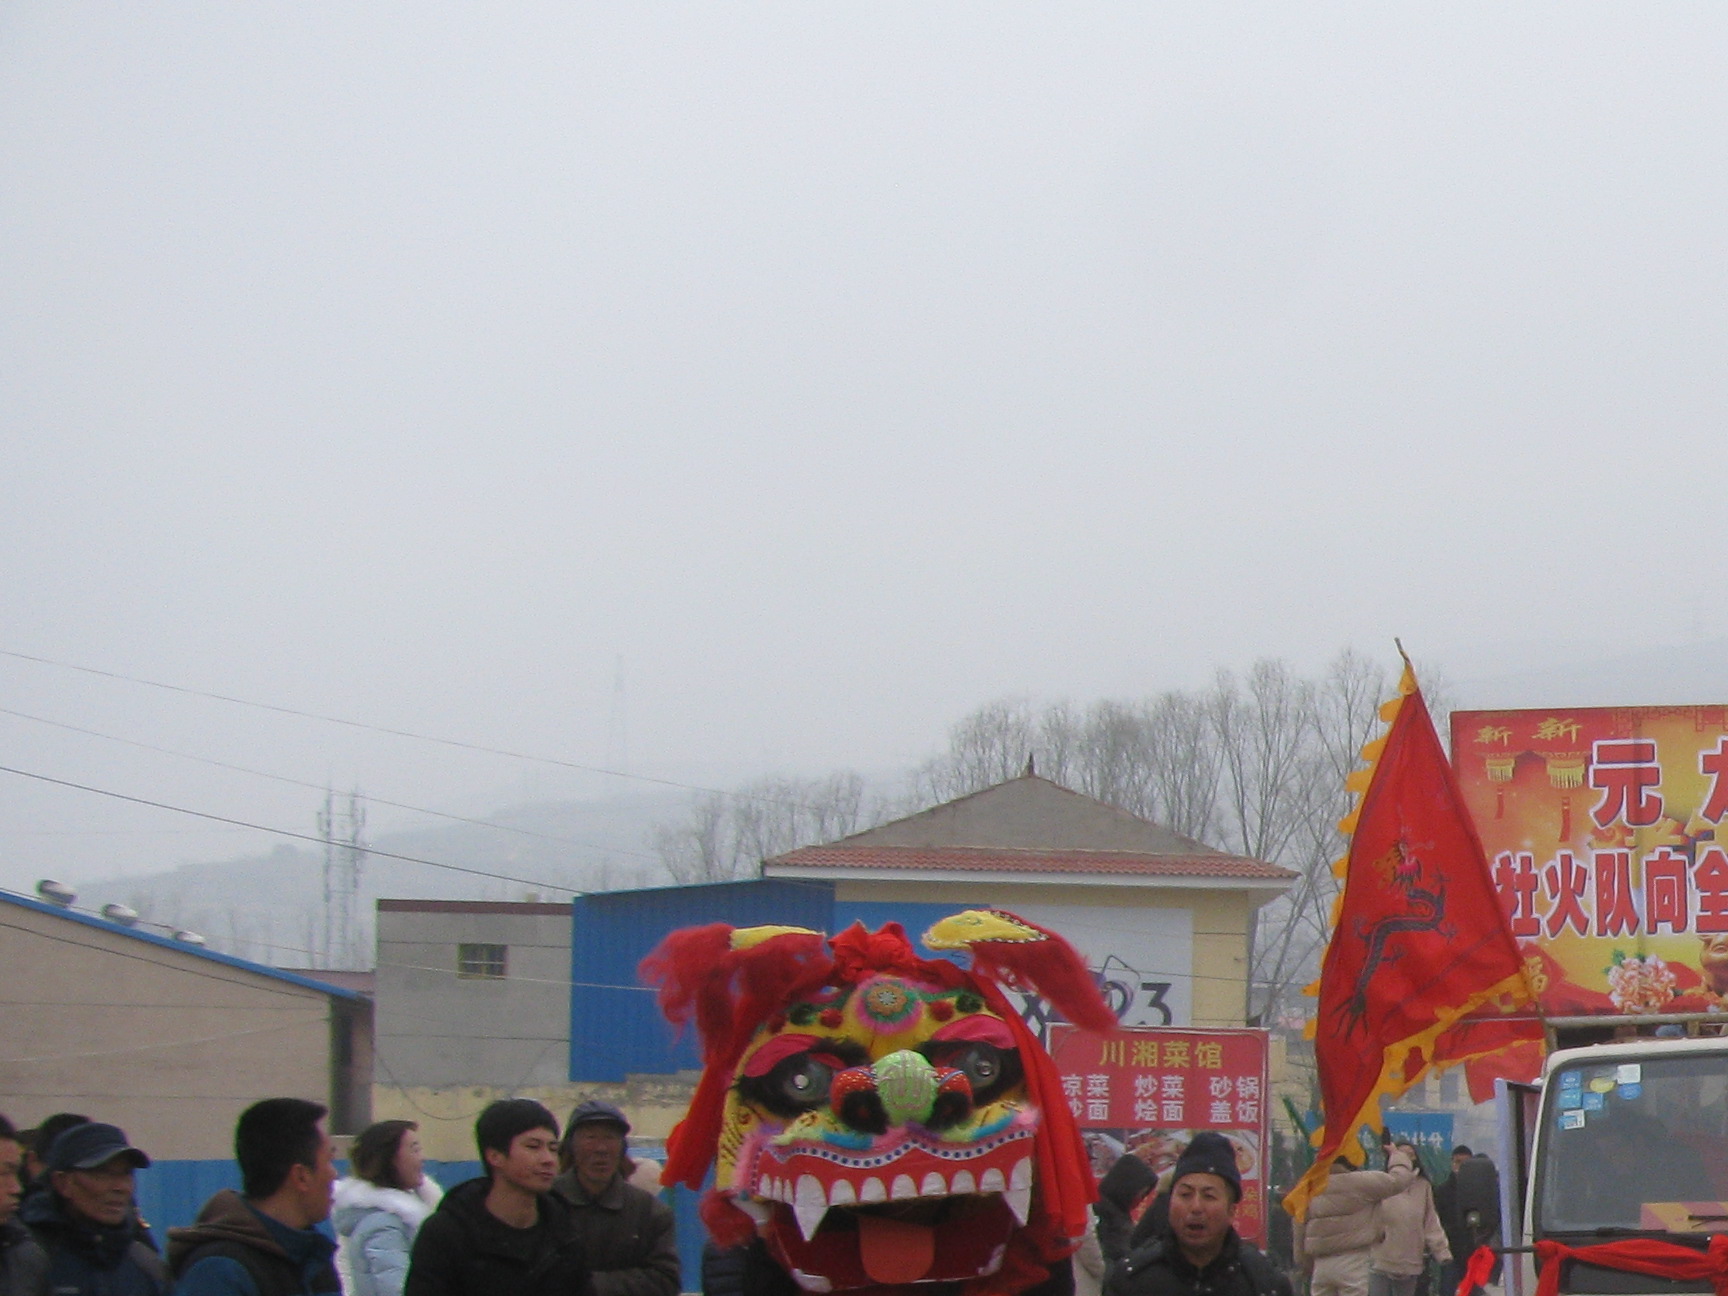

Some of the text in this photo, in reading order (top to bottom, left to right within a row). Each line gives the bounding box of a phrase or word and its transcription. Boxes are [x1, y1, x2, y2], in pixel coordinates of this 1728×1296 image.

[1099, 1040, 1224, 1070] 川湘菜馆
[1134, 1074, 1184, 1098] 炒菜
[1209, 1075, 1259, 1100] 砂锅
[1134, 1100, 1185, 1122] 烩面
[1210, 1101, 1259, 1123] 盖饭
